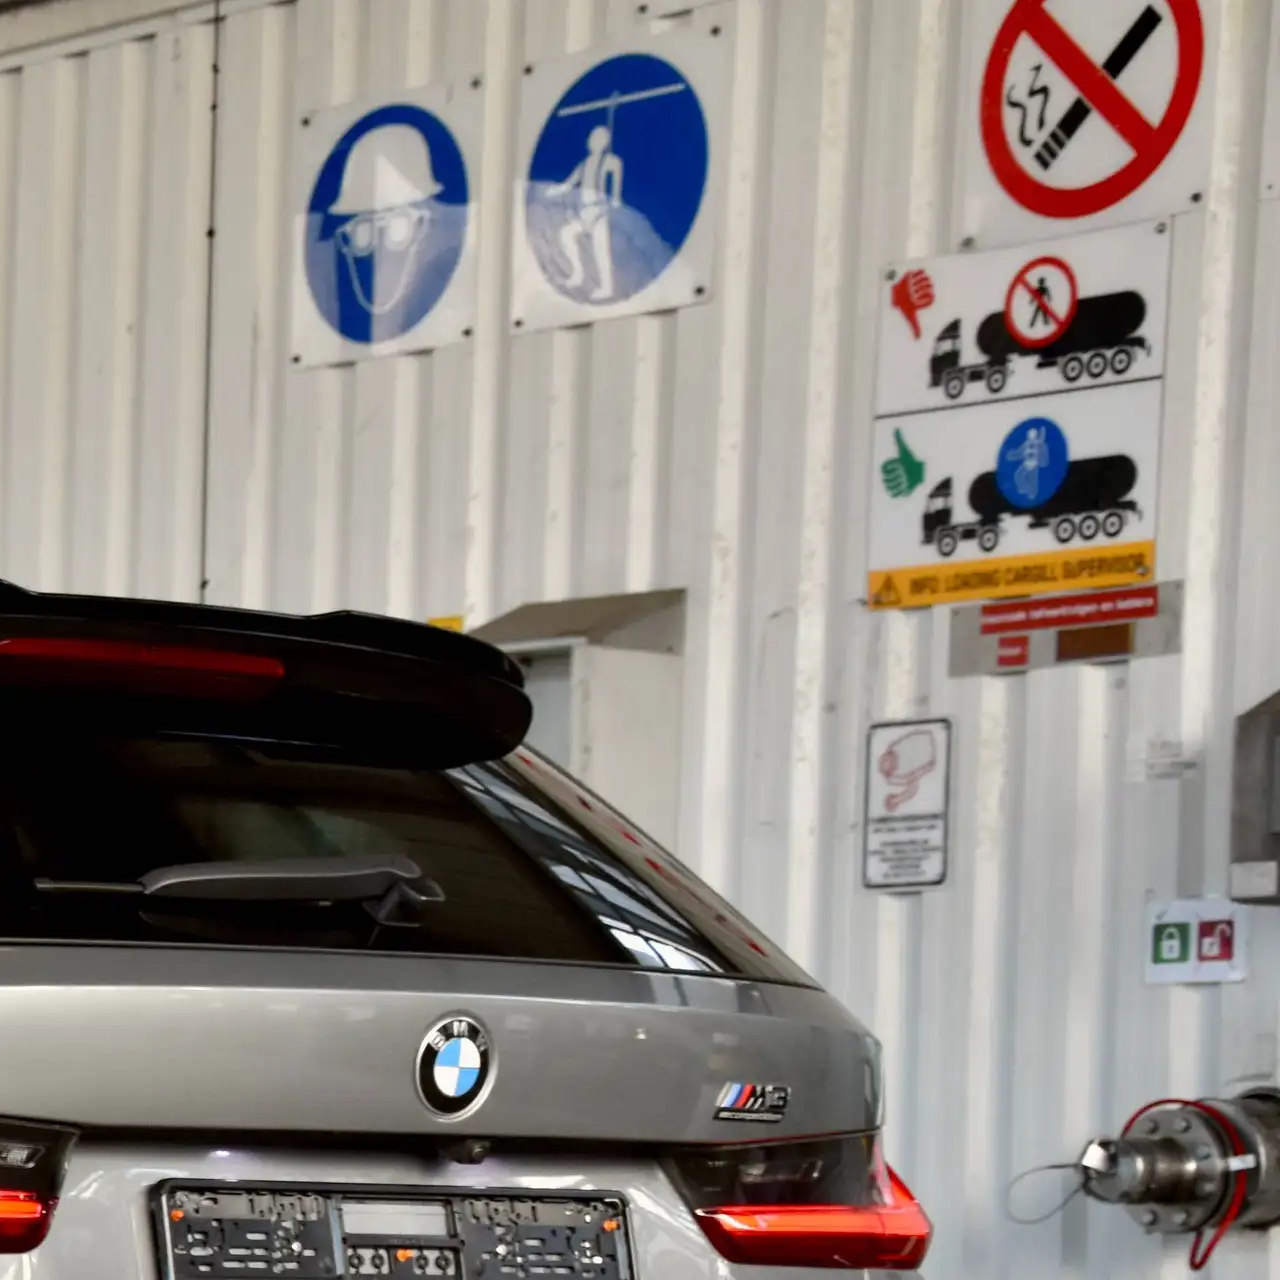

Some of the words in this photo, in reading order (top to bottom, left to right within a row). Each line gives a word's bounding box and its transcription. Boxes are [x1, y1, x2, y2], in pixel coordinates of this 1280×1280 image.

[944, 567, 1000, 593] LOADING
[1004, 562, 1058, 588] CARGILL
[1062, 552, 1146, 580] SUPERVISOR
[429, 1020, 489, 1052] BMW
